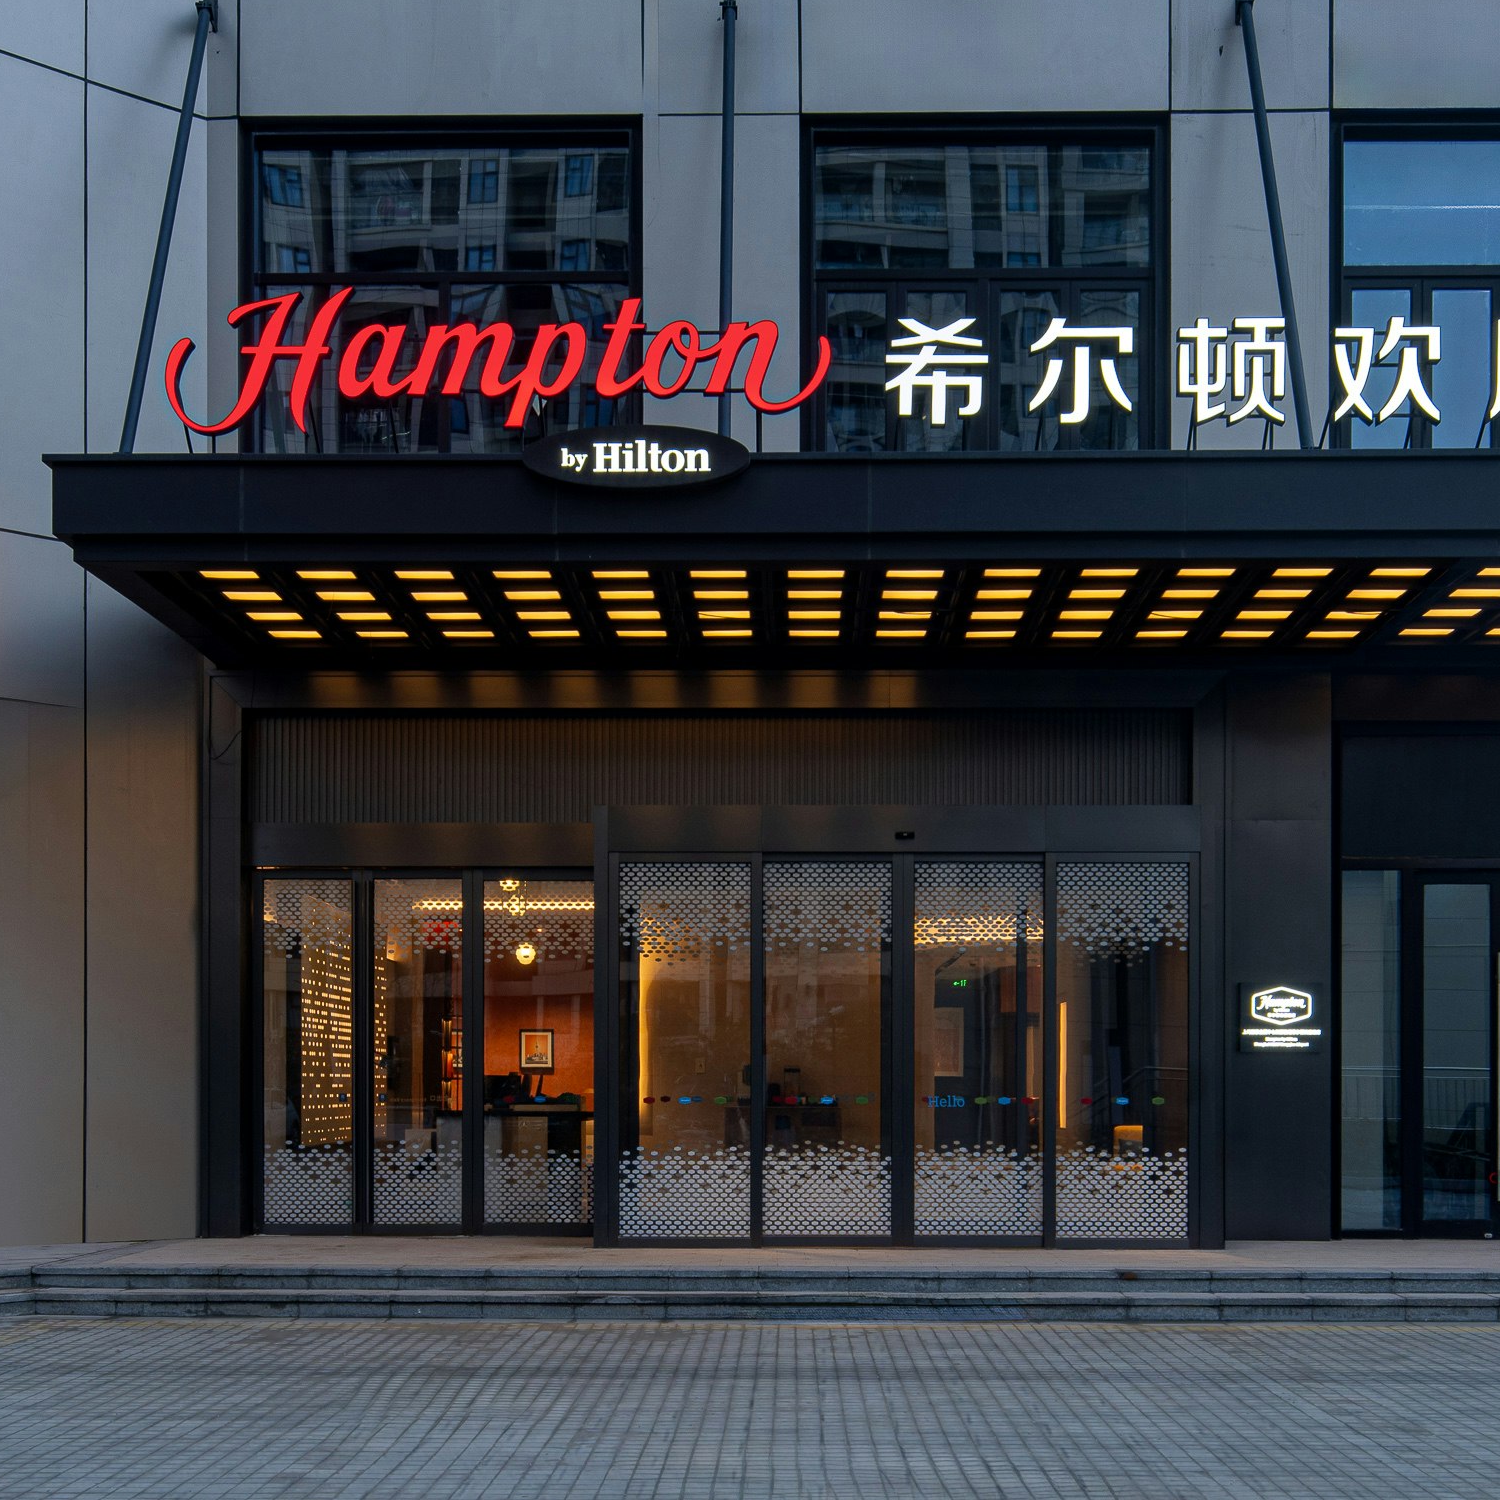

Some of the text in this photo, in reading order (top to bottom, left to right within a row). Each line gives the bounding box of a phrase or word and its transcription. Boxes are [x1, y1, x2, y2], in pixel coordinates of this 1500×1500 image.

[165, 287, 831, 434] Hampton
[560, 440, 712, 473] by Hilton
[928, 1094, 966, 1108] Hello
